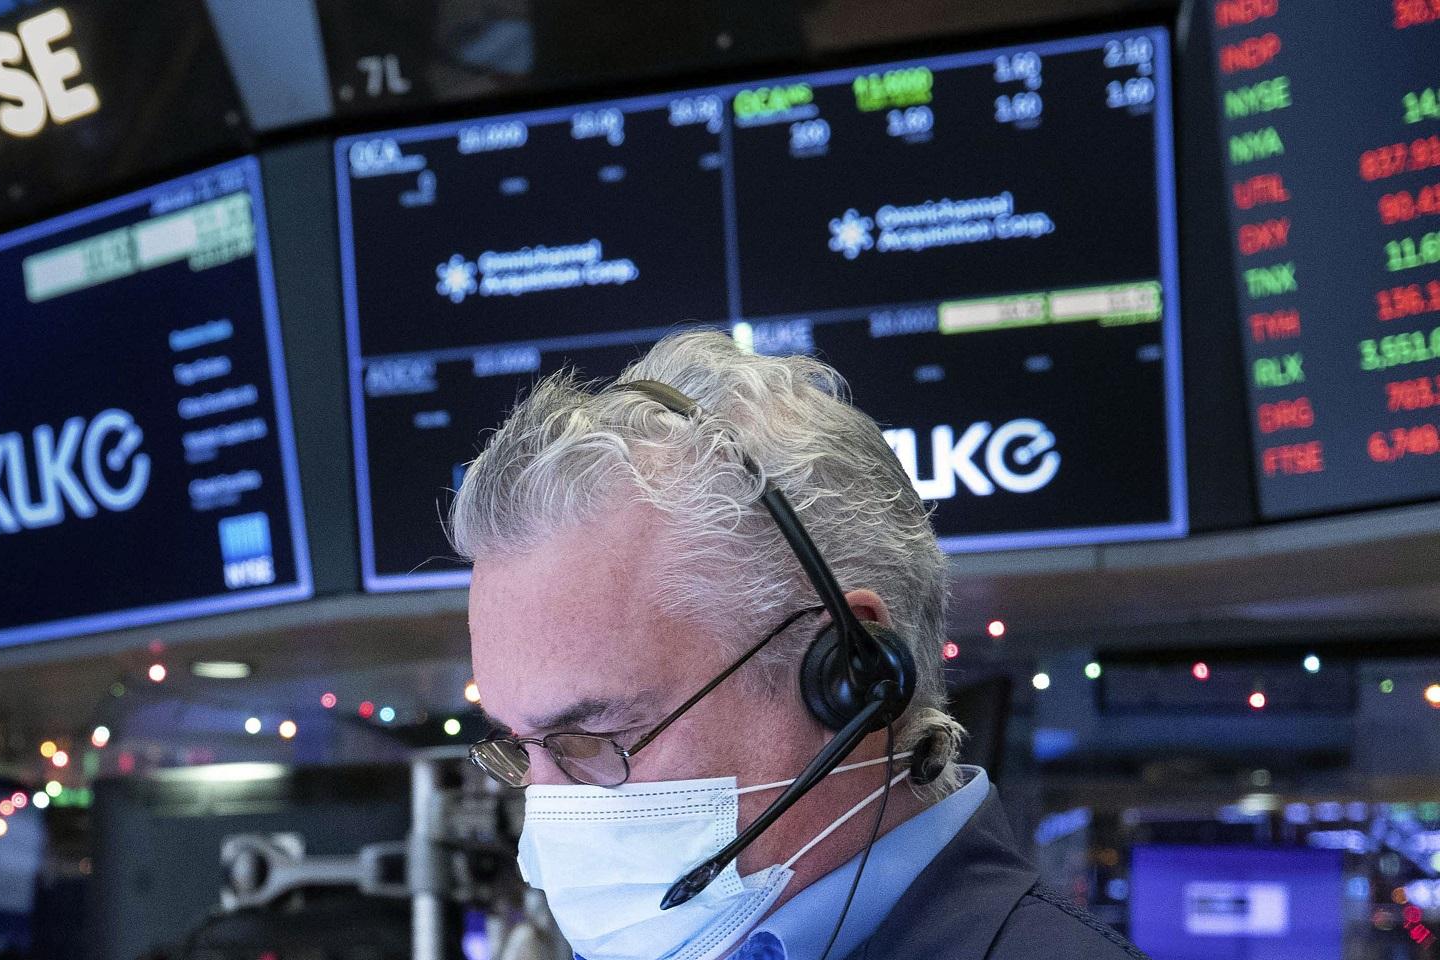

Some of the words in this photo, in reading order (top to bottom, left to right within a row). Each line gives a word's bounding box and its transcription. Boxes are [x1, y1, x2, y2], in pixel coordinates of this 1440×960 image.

[1224, 75, 1291, 119] NYSE
[1252, 352, 1305, 388] RLX
[1262, 440, 1324, 477] FTSE
